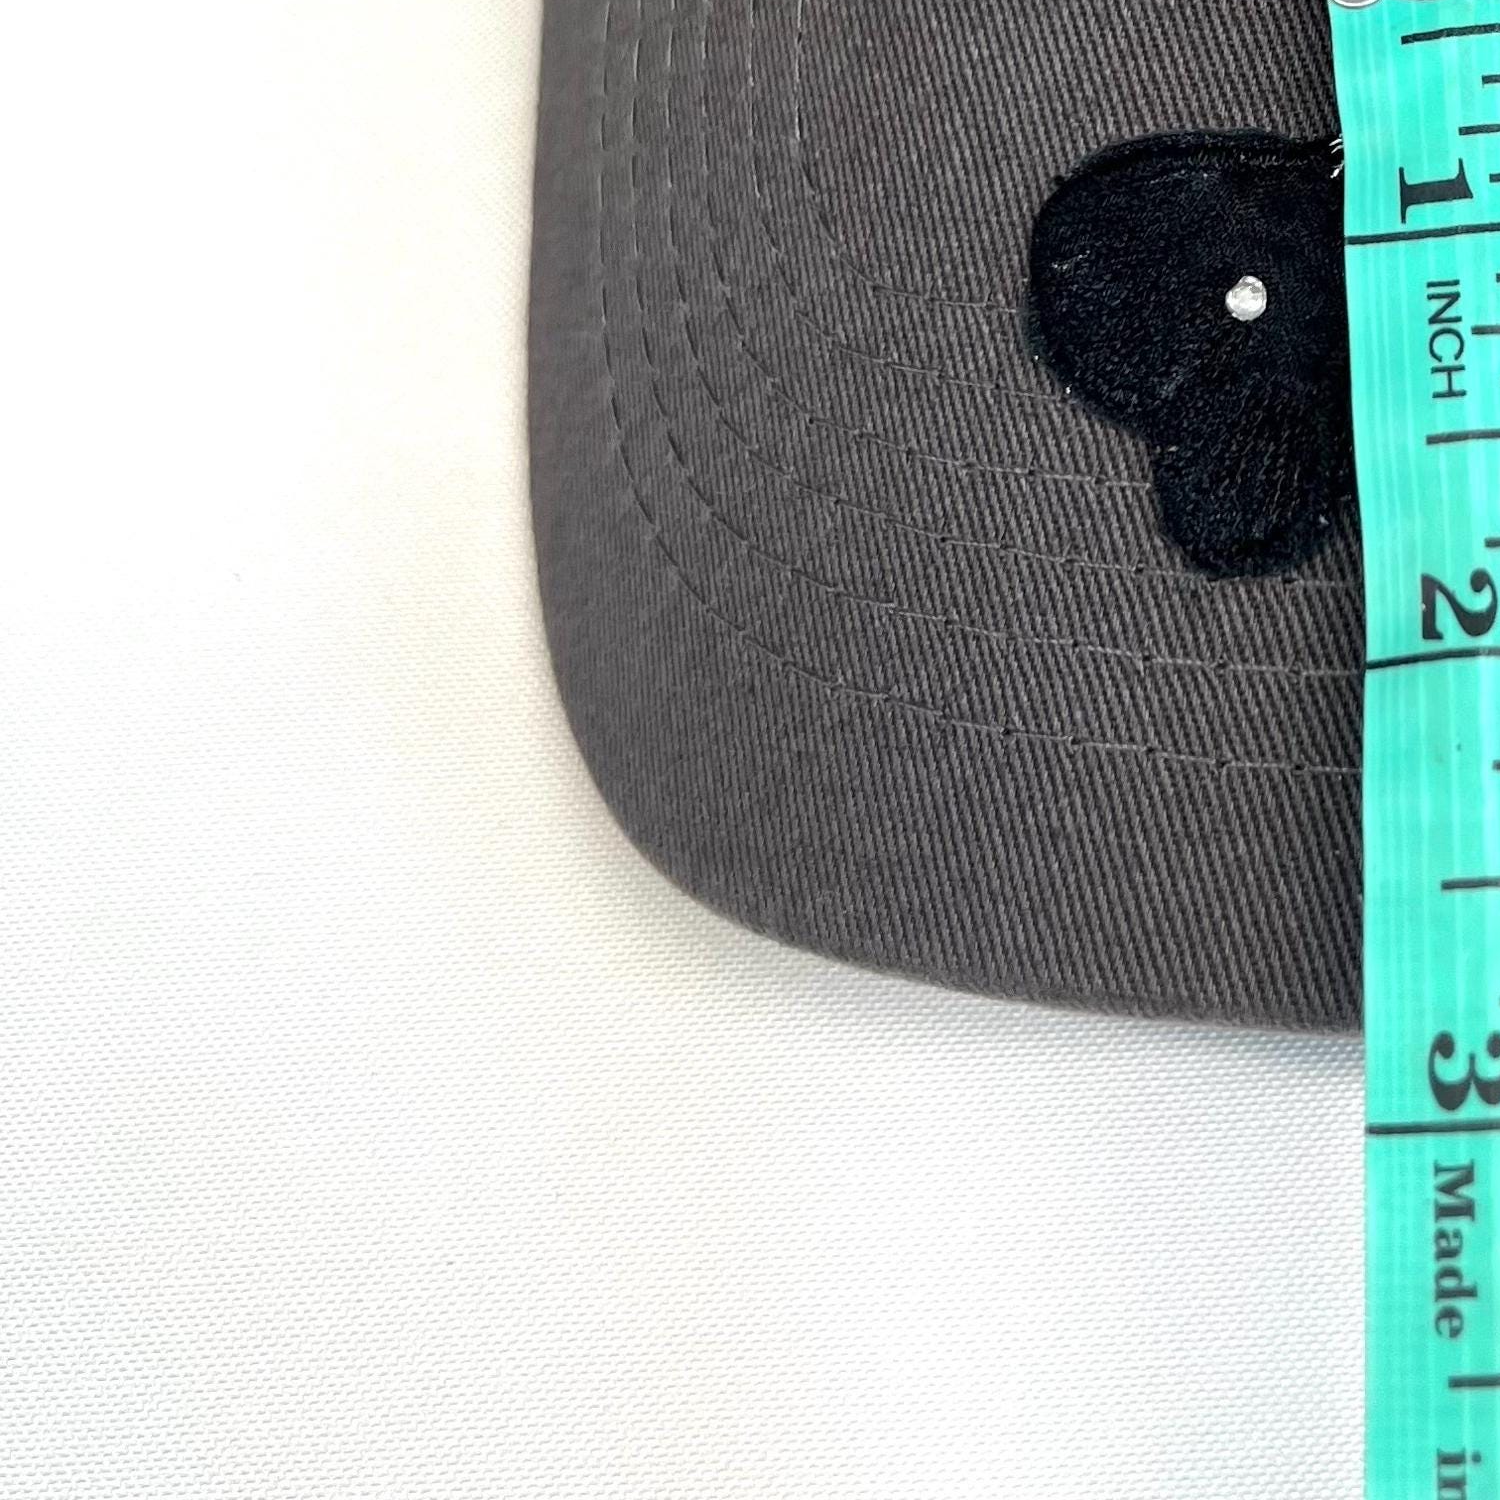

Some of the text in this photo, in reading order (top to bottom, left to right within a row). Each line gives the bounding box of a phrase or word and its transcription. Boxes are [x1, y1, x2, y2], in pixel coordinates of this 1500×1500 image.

[1399, 158, 1474, 224] 1
[1426, 279, 1467, 399] INCH
[1421, 568, 1498, 641] 2
[1433, 1159, 1478, 1340] Made
